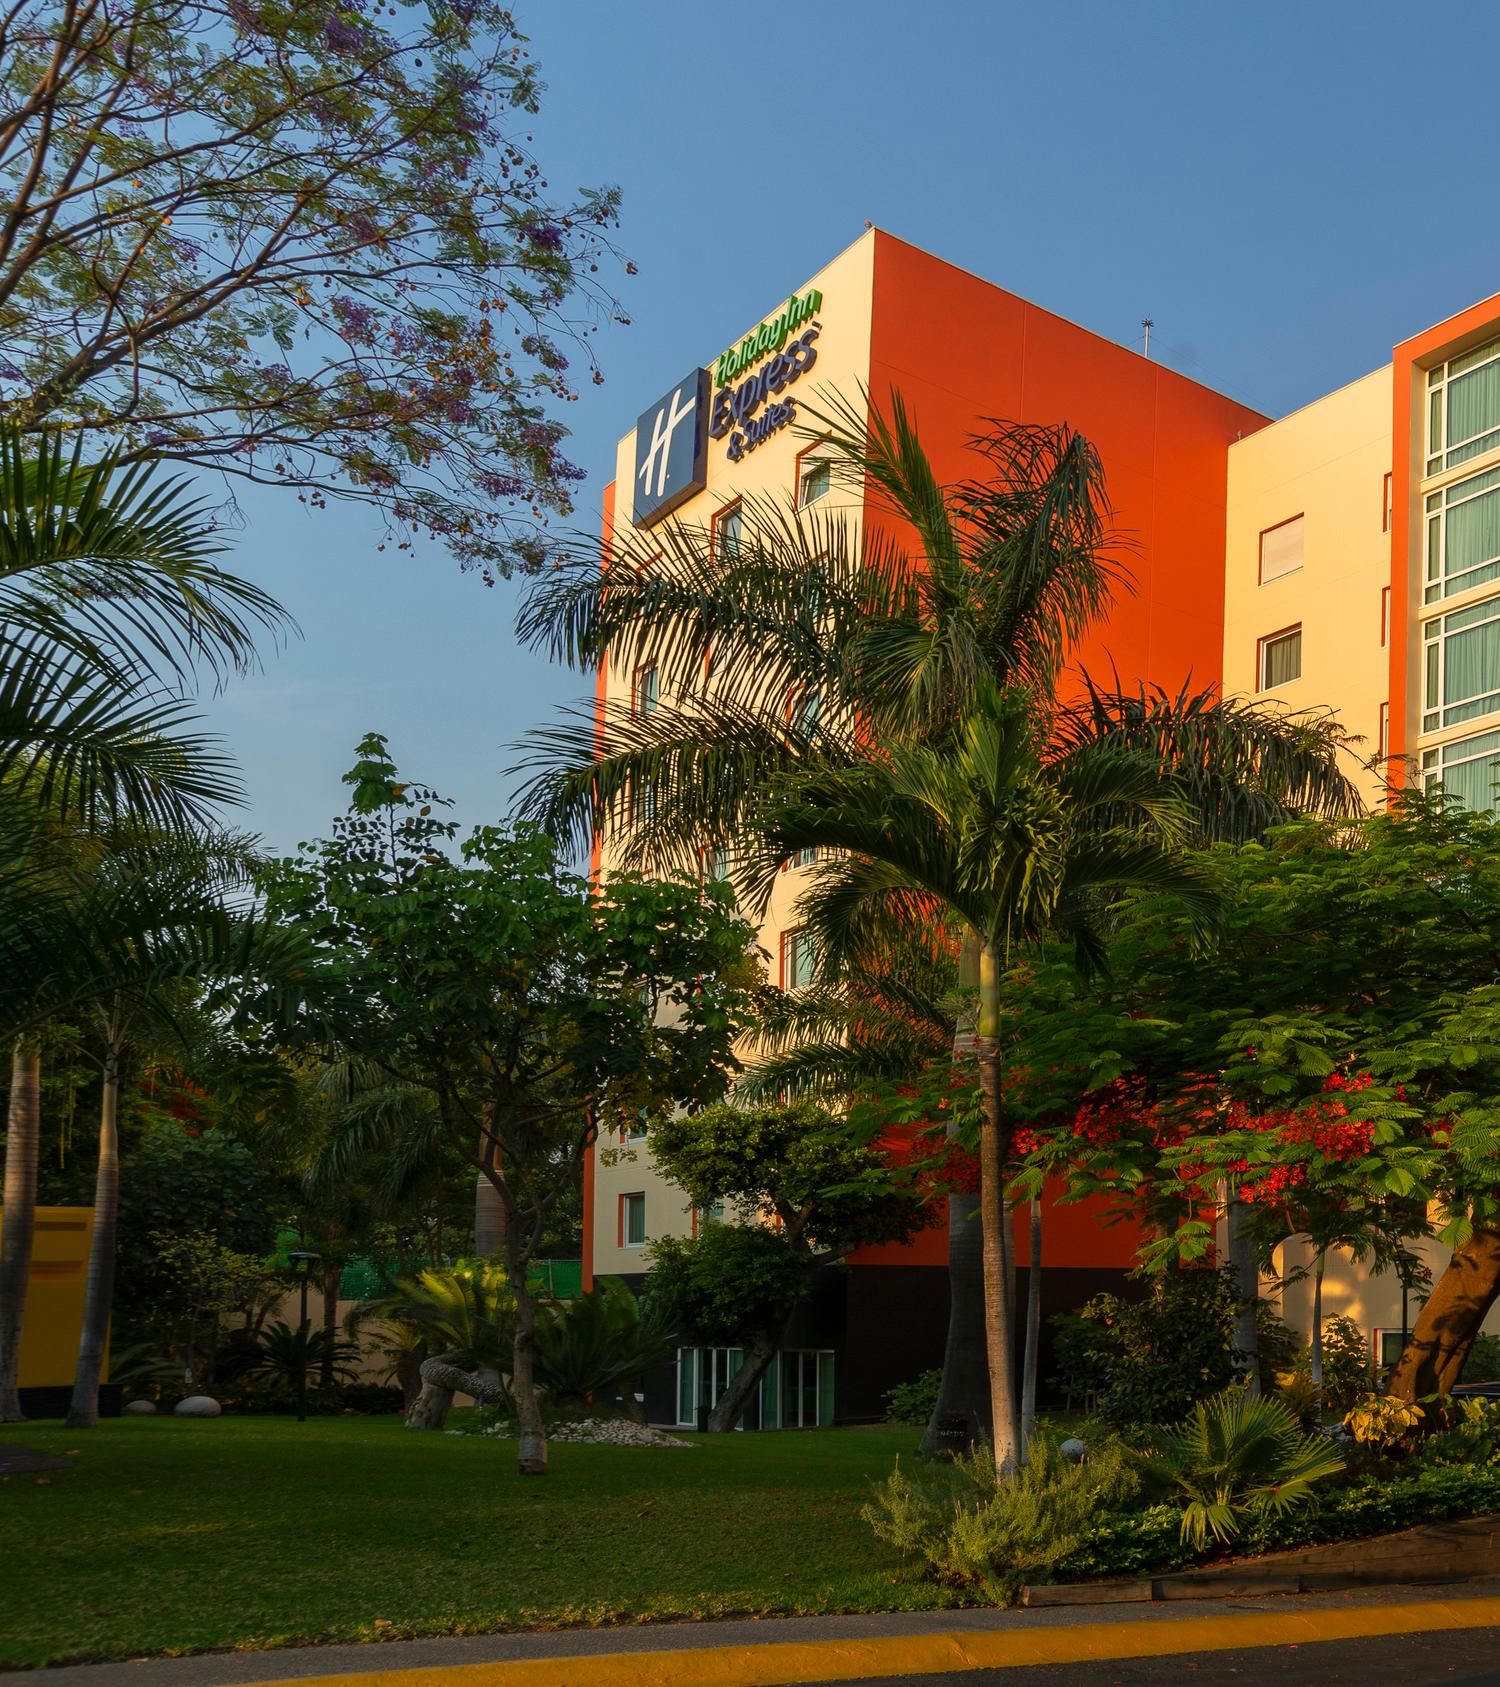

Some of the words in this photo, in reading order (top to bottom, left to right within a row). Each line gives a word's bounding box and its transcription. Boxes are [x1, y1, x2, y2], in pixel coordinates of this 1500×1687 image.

[709, 328, 818, 440] Express
[714, 313, 789, 390] Holiday
[784, 288, 823, 332] Inn
[727, 431, 744, 463] &
[742, 395, 797, 453] Suites
